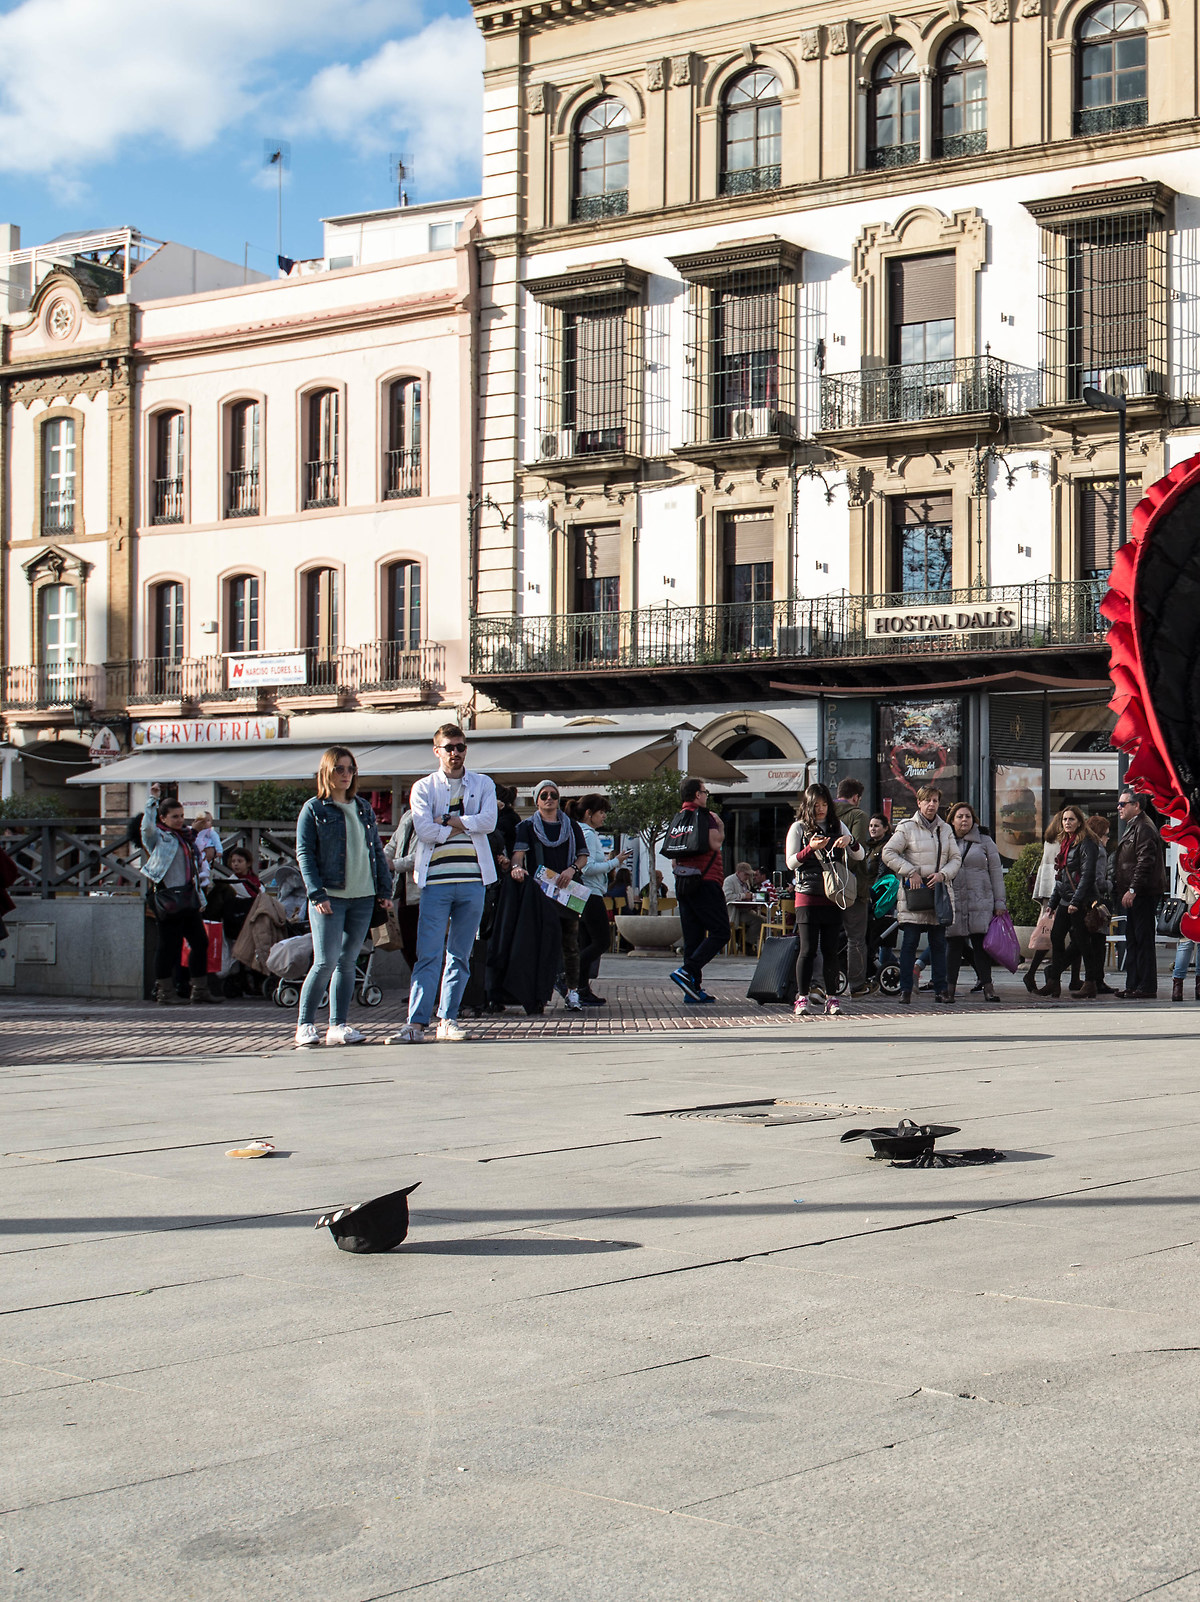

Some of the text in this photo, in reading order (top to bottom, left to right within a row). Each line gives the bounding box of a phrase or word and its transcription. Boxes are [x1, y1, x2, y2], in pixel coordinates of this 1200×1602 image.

[874, 606, 1016, 634] HOSTAL DALÍS
[245, 666, 268, 676] NARCISO
[147, 720, 262, 745] CERVECERÍA
[827, 703, 838, 789] PRENSA
[1066, 768, 1106, 781] TAPAS
